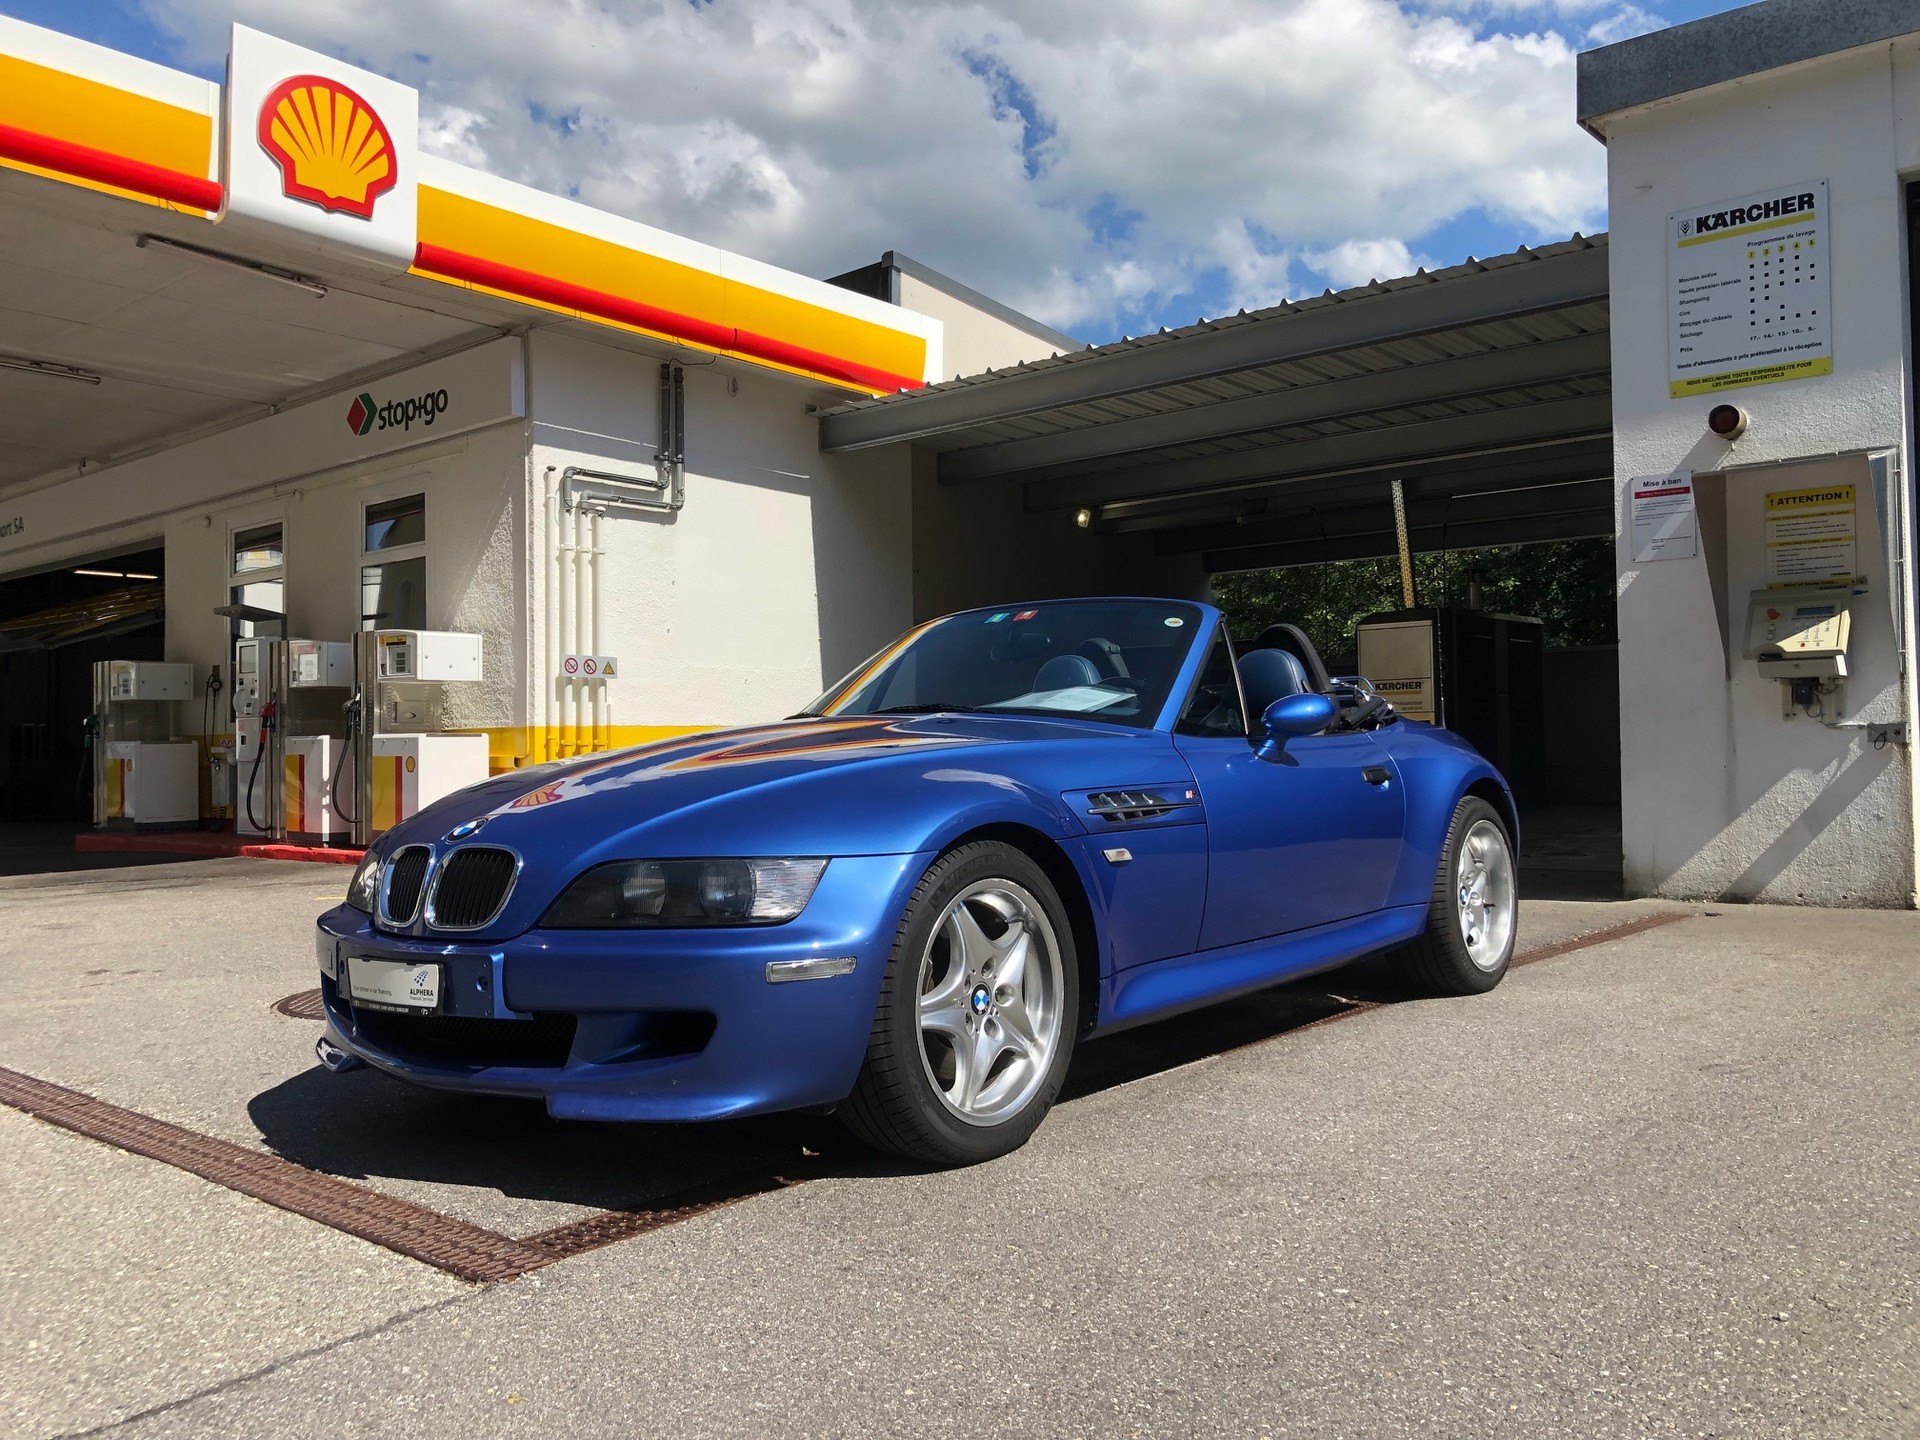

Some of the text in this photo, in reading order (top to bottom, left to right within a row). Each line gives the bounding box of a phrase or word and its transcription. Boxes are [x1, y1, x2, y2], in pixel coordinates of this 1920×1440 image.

[1696, 192, 1815, 234] KÄRCHER
[1747, 236, 1785, 248] Programmes
[1795, 229, 1816, 239] lavage
[1678, 271, 1717, 284] Mousse active
[1678, 286, 1695, 295] Haute
[1679, 295, 1710, 306] Shampoing
[1679, 319, 1702, 328] Rinçage
[1711, 313, 1733, 322] châssis
[1679, 330, 1703, 339] Séchage
[1677, 362, 1692, 370] Vente
[1693, 356, 1733, 367] d'abonnements
[1738, 352, 1749, 361] prix
[1750, 346, 1782, 358] préférentiel
[1795, 341, 1823, 352] réception
[1723, 376, 1752, 386] DOMMAGES
[1732, 371, 1749, 379] TOUTE
[378, 389, 448, 431] stop+go
[1777, 491, 1842, 506] ATTENTION
[14, 516, 25, 534] SA
[409, 988, 434, 997] ALPHERA
